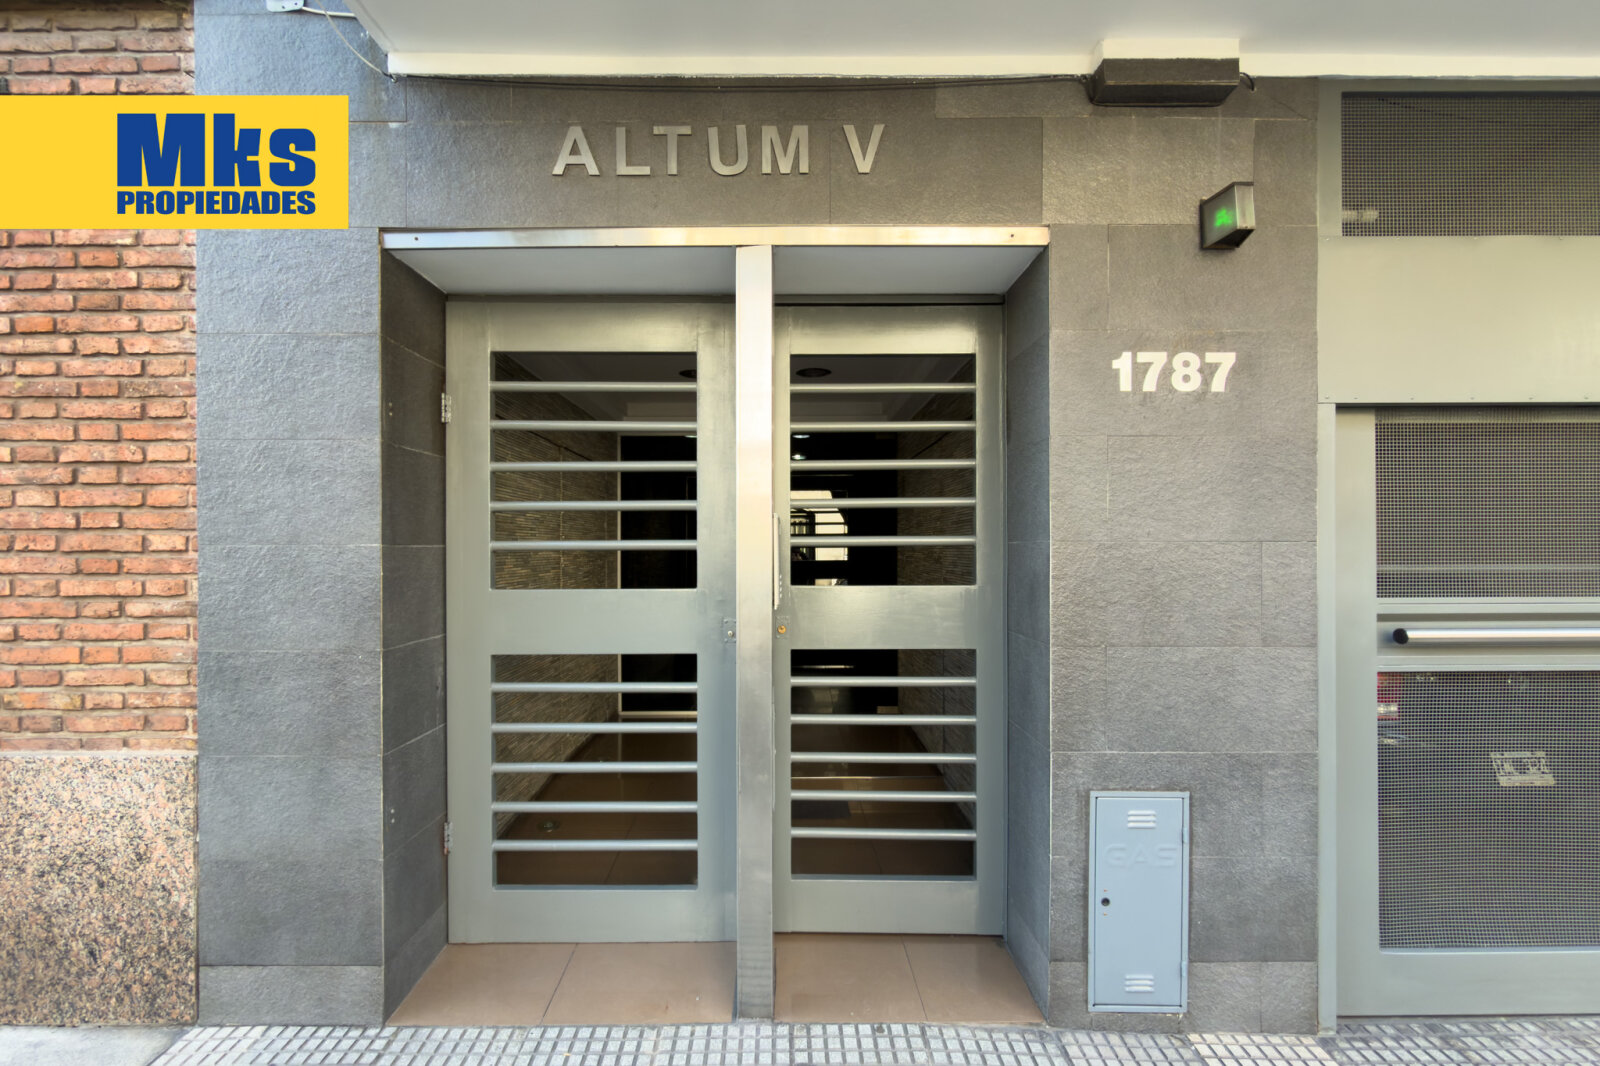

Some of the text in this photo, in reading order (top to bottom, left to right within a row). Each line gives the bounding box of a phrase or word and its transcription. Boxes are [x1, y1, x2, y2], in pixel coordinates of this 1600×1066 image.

[551, 124, 886, 176] ALTUM V
[1111, 351, 1237, 392] 1787
[1104, 843, 1178, 869] GAS
